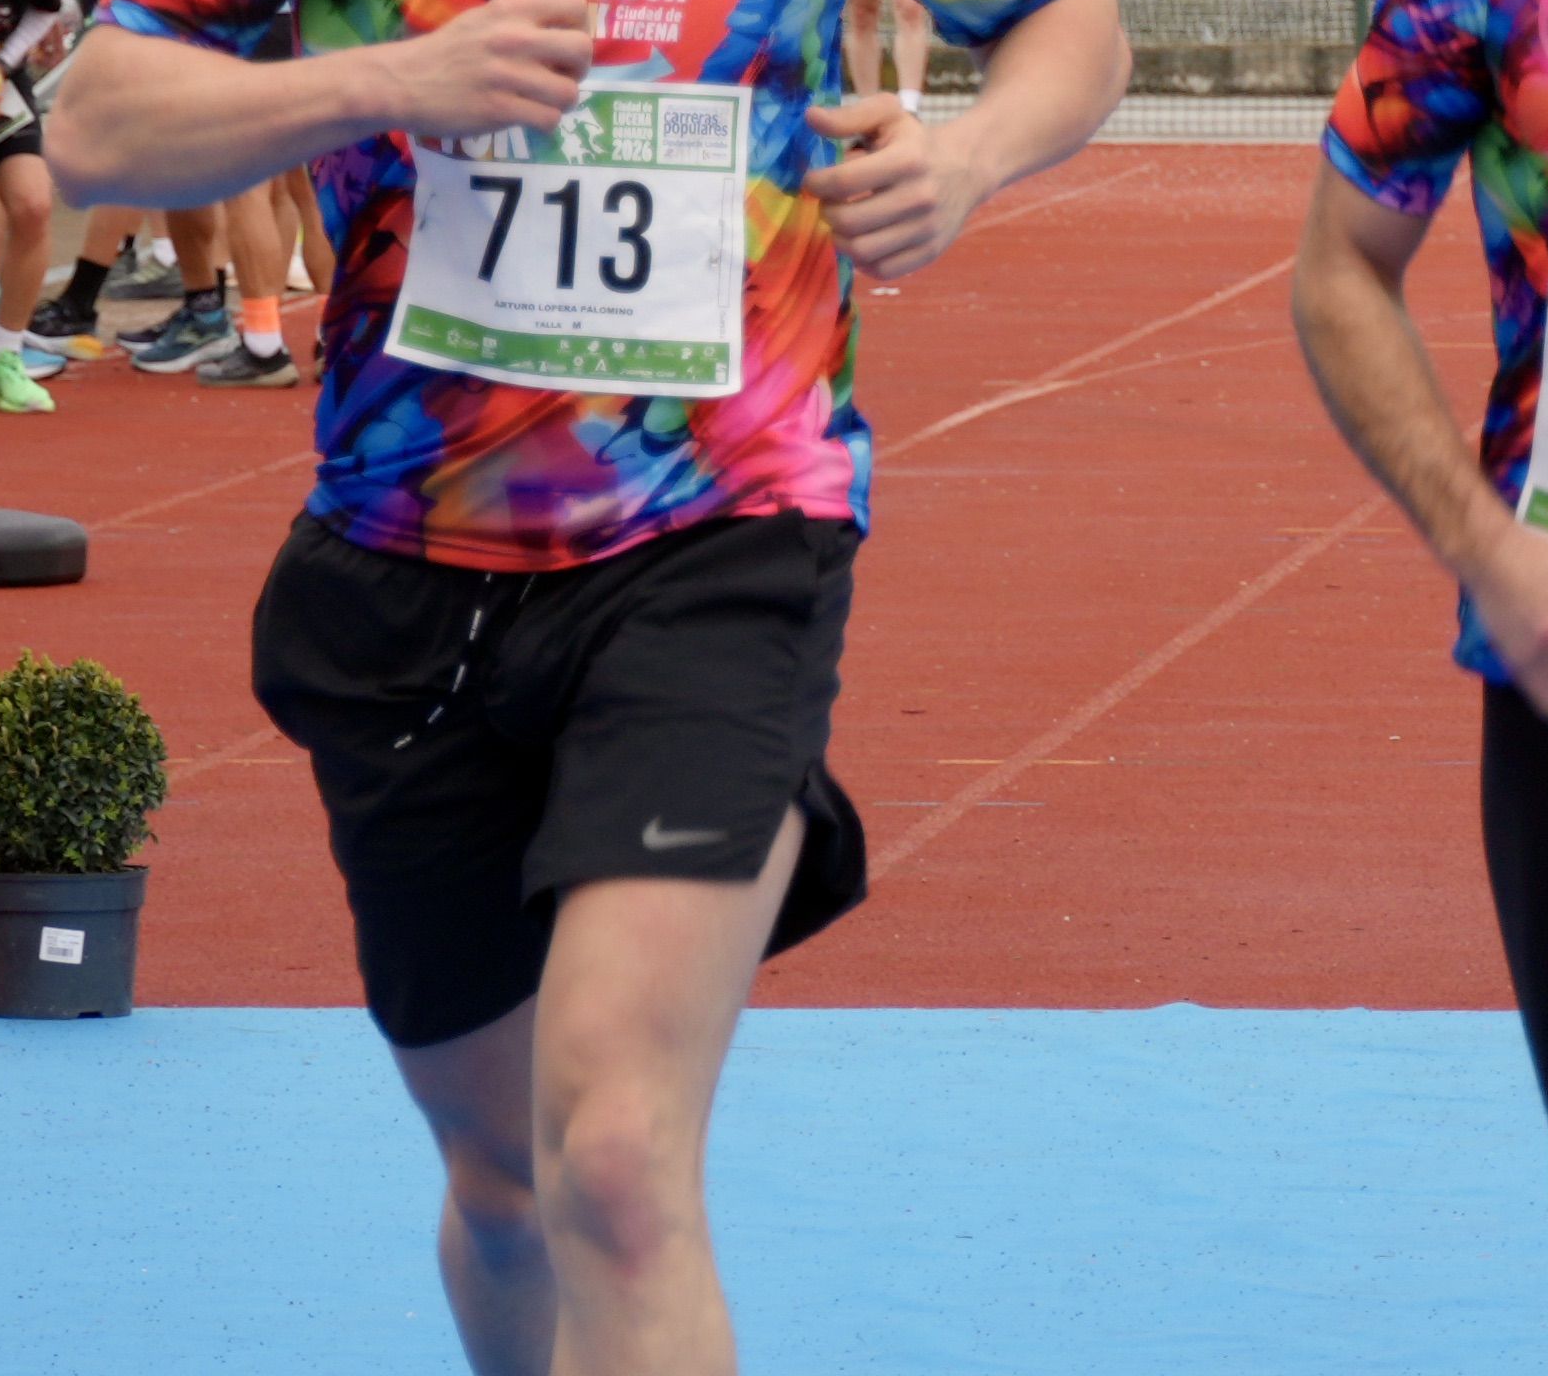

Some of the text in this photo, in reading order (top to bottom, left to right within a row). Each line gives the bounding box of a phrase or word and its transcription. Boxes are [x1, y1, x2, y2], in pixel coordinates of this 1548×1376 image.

[615, 5, 662, 22] Ciudad
[665, 8, 683, 23] de
[612, 20, 681, 43] LUCENA
[663, 110, 719, 125] carreras
[663, 123, 729, 137] populares
[612, 138, 652, 162] 2026
[469, 174, 653, 294] 713
[572, 321, 582, 330] M
